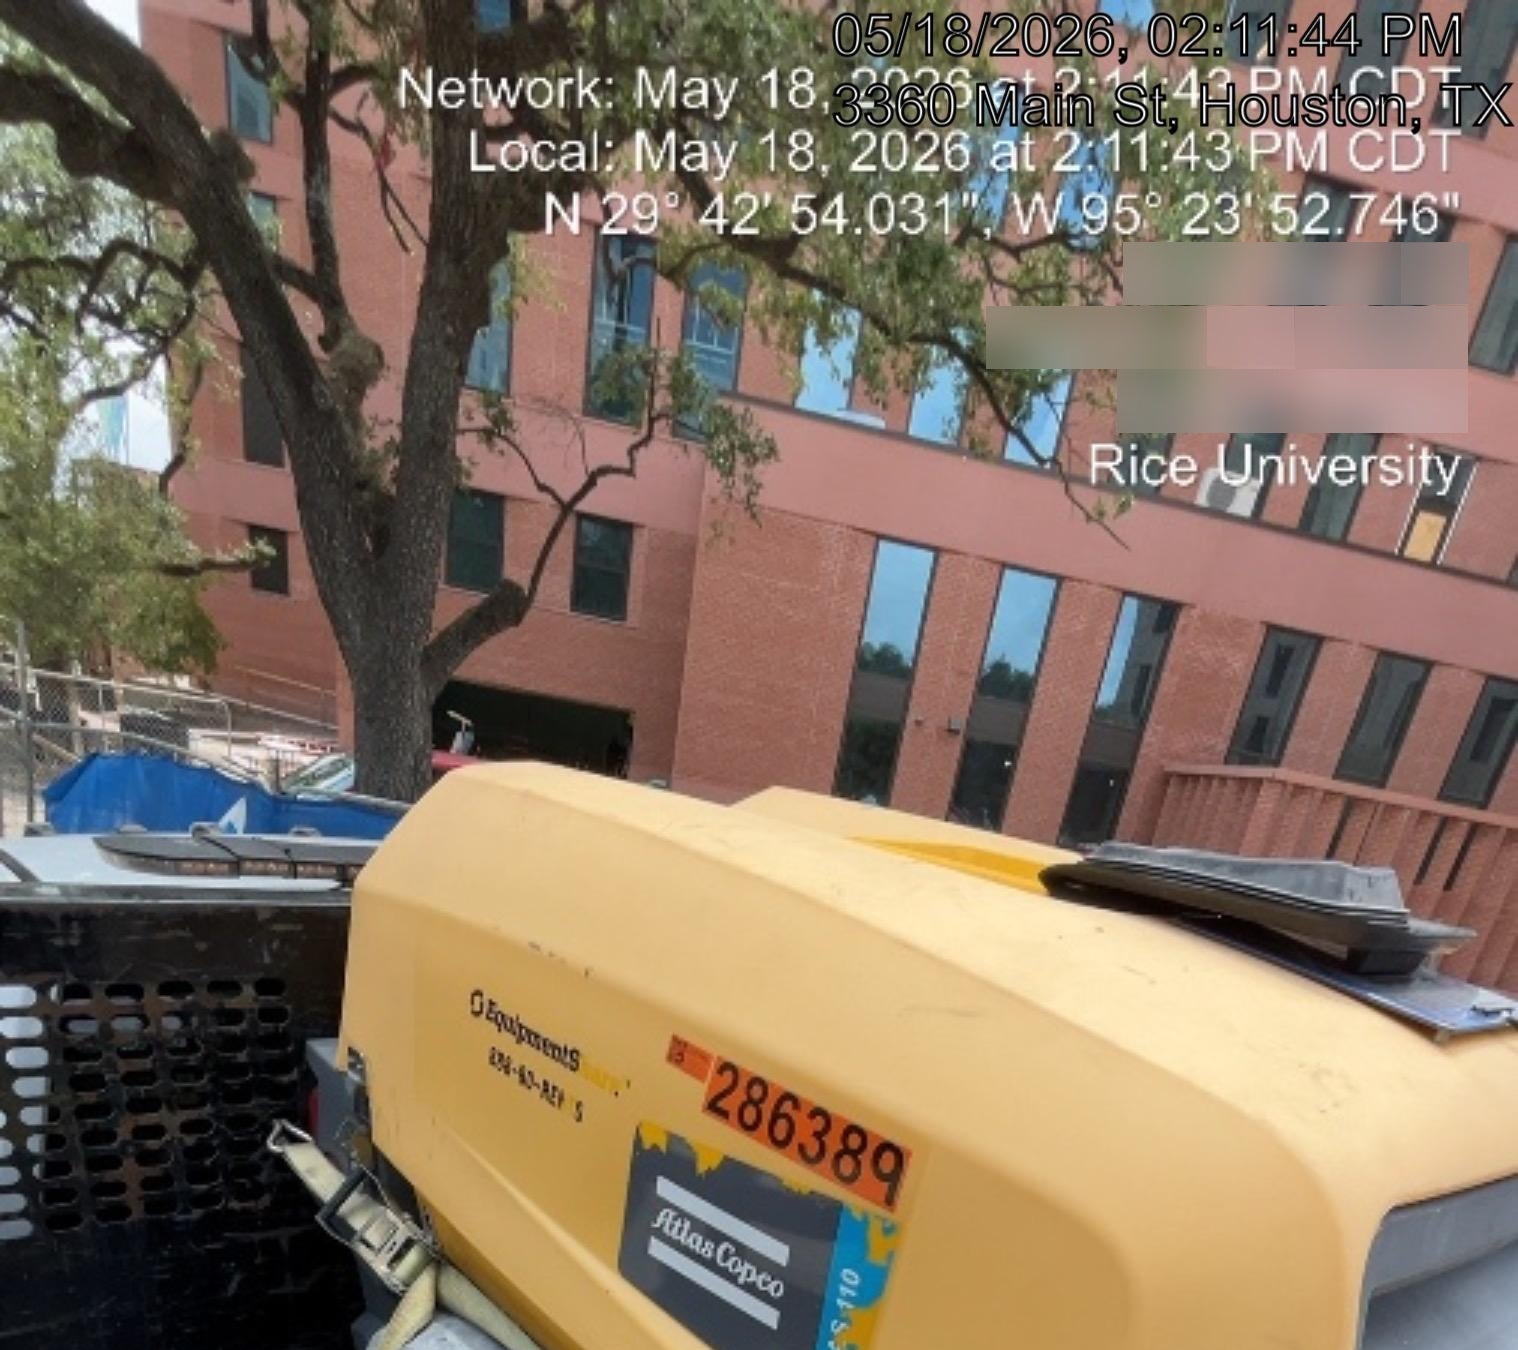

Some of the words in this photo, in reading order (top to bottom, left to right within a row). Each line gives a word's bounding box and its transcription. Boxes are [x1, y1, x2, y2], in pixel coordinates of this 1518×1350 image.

[486, 998, 614, 1086] EquipmentS
[707, 1060, 906, 1208] 286389
[651, 1207, 714, 1259] Atlas
[714, 1241, 785, 1299] Copco
